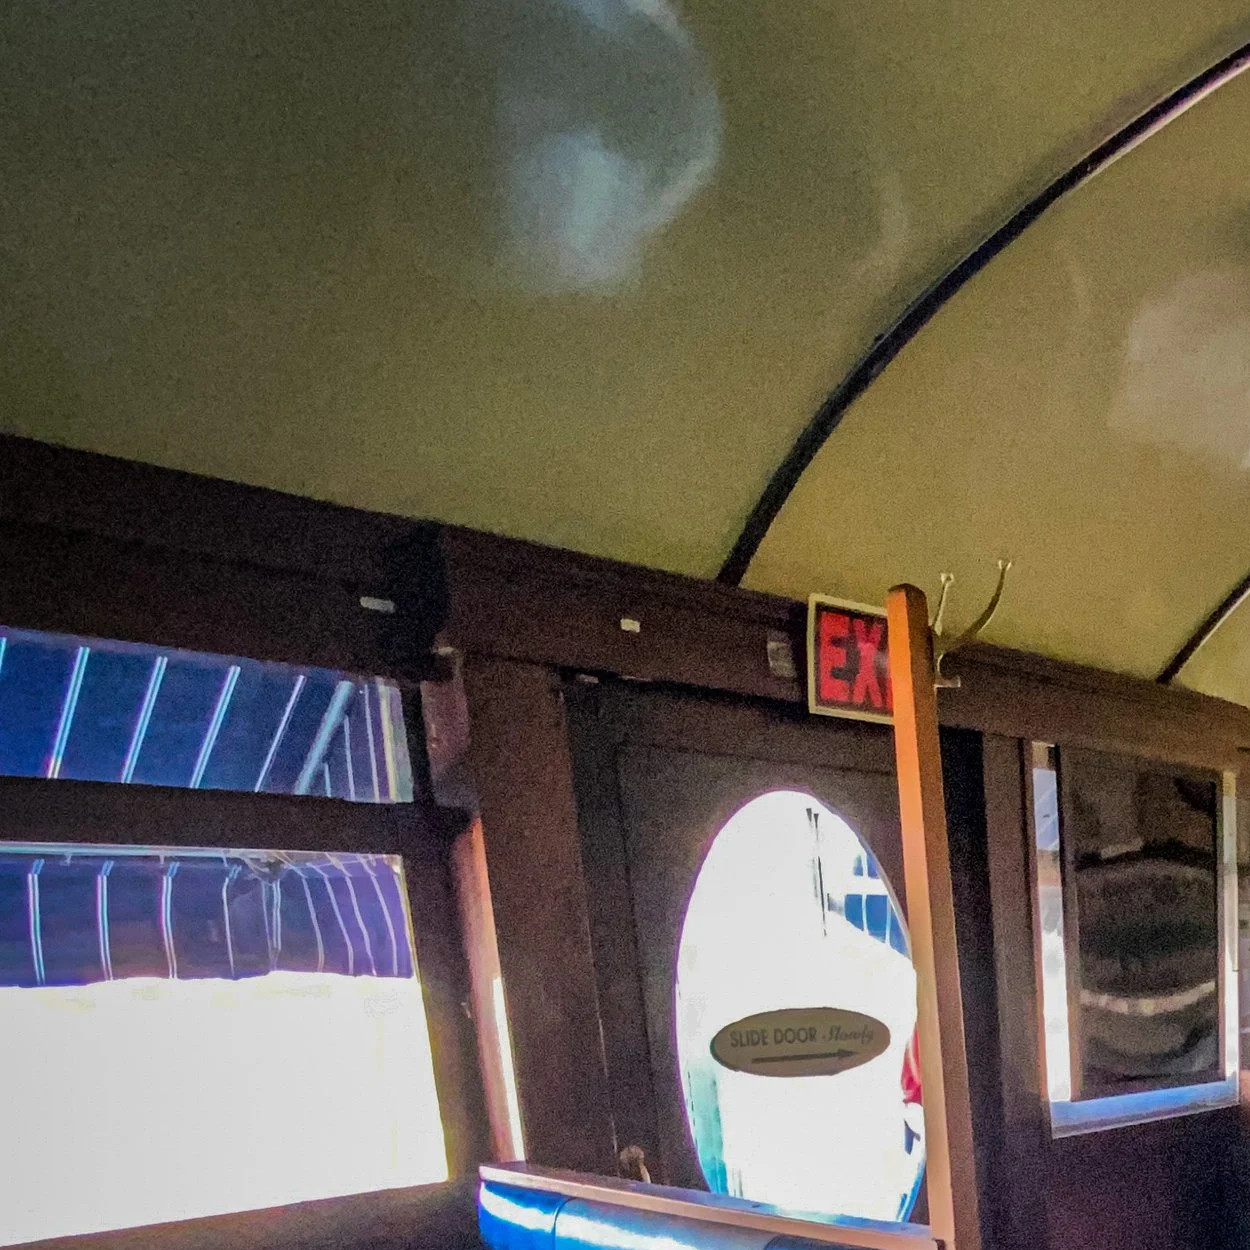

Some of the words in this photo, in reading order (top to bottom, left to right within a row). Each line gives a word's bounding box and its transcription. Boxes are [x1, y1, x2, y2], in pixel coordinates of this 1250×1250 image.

[820, 611, 893, 709] EX
[730, 1027, 768, 1048] SLIDE
[773, 1027, 817, 1045] DOOR
